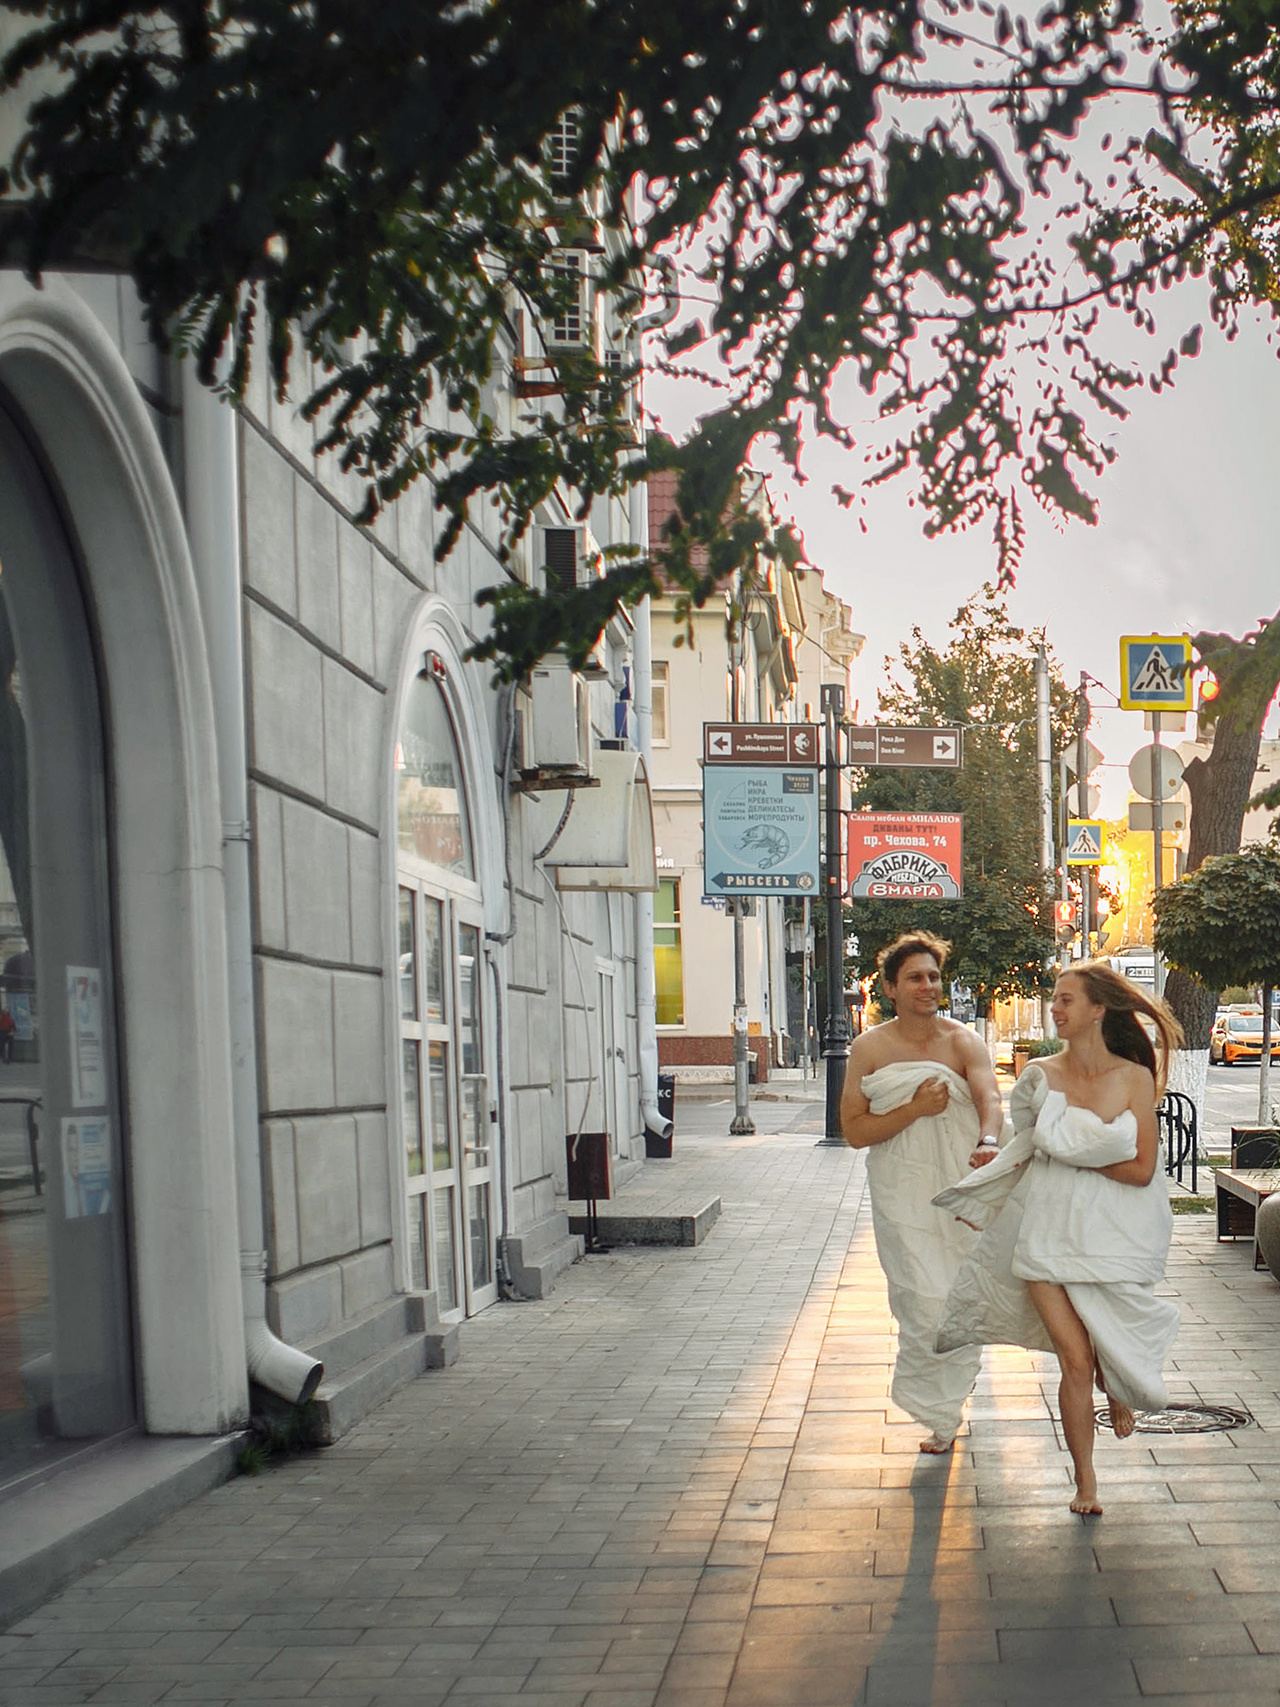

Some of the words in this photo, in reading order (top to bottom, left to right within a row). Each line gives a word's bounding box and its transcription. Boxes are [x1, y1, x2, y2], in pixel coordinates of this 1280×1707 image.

[753, 733, 784, 741] Пушкинская
[747, 805, 795, 813] ДЕЛИКАТЕСЫ
[748, 814, 805, 822] МОРЕПРОДУКТЫ
[850, 813, 875, 822] Салон
[876, 814, 906, 822] мебели
[906, 815, 960, 823] «МИЛАНО»
[873, 824, 913, 833] ДИВАНЫ
[915, 825, 937, 833] ТУТ!
[863, 836, 882, 847] пр.
[885, 835, 929, 847] Чехова,
[933, 835, 947, 847] 74
[871, 854, 939, 881] ФАБРИКА
[726, 875, 790, 886] РЫБСЕТЬ
